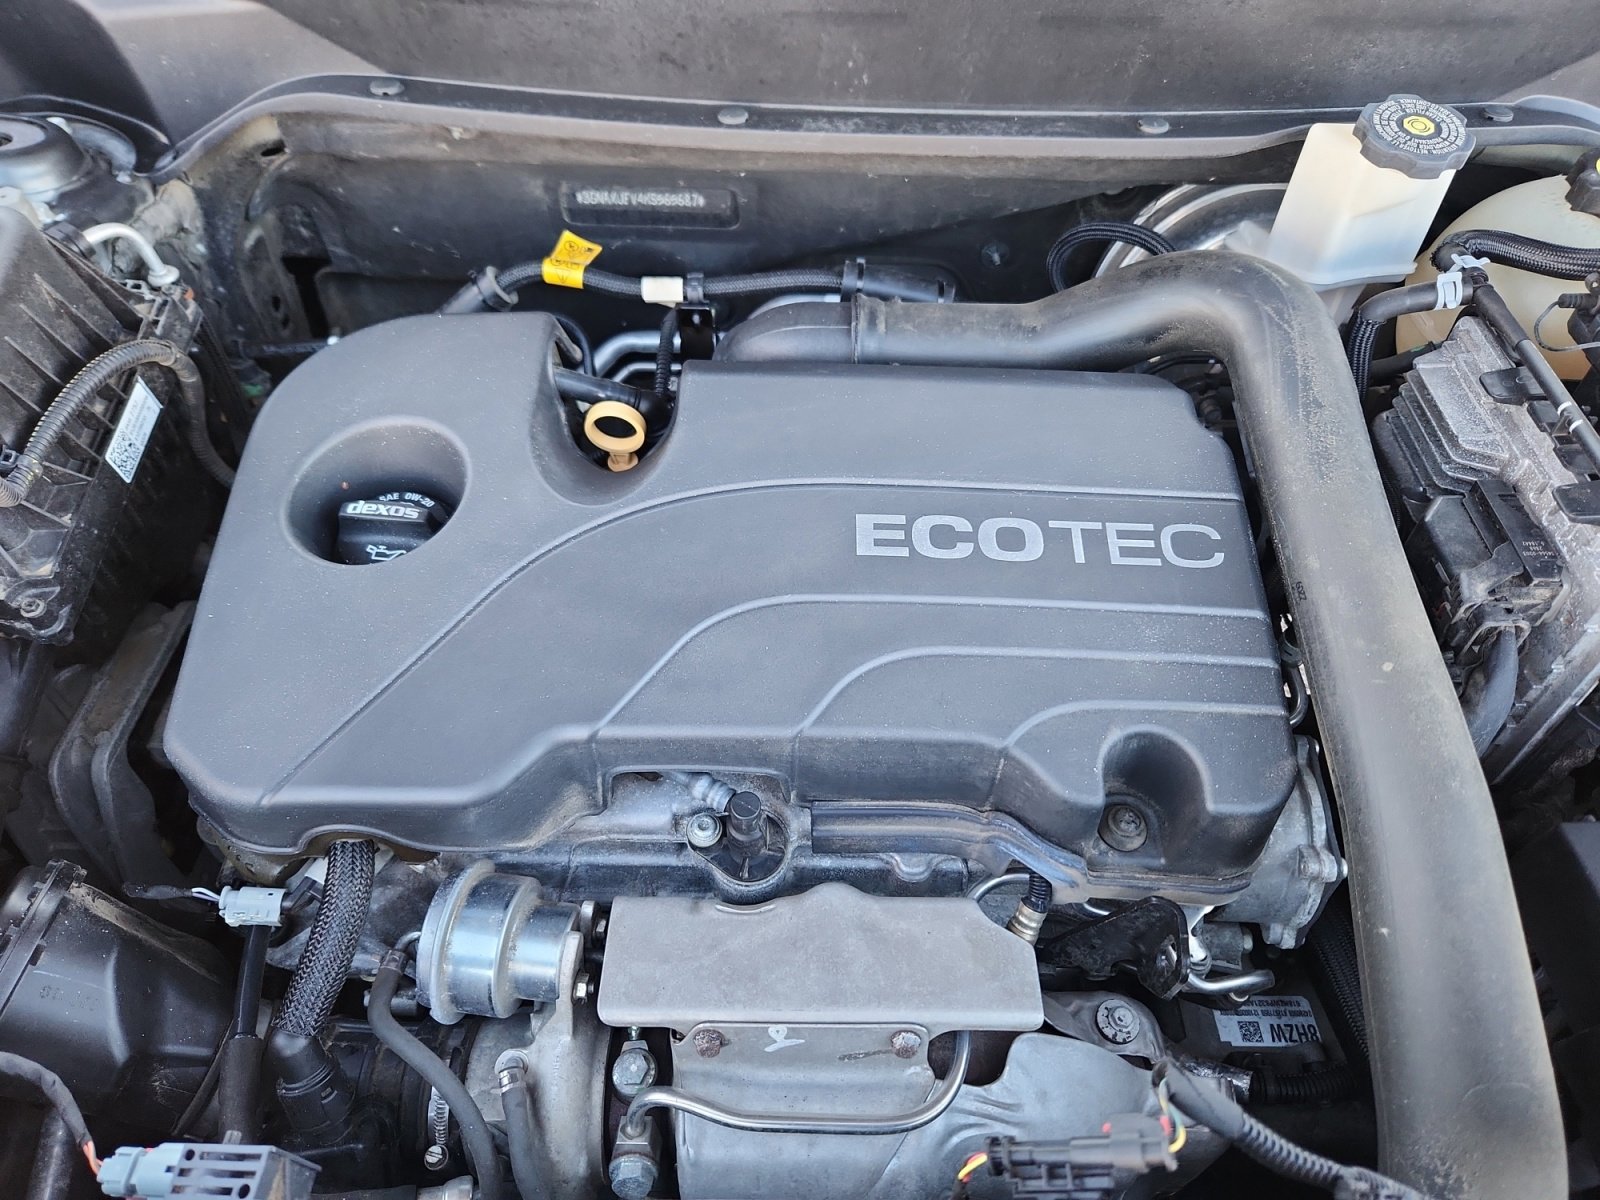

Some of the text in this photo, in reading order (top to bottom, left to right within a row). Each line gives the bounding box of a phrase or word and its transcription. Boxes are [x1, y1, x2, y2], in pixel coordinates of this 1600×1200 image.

[346, 500, 420, 519] dexos
[379, 492, 436, 508] SAE 0W-20
[855, 513, 1225, 569] ECOTEC
[1269, 1023, 1320, 1043] 8HZW
